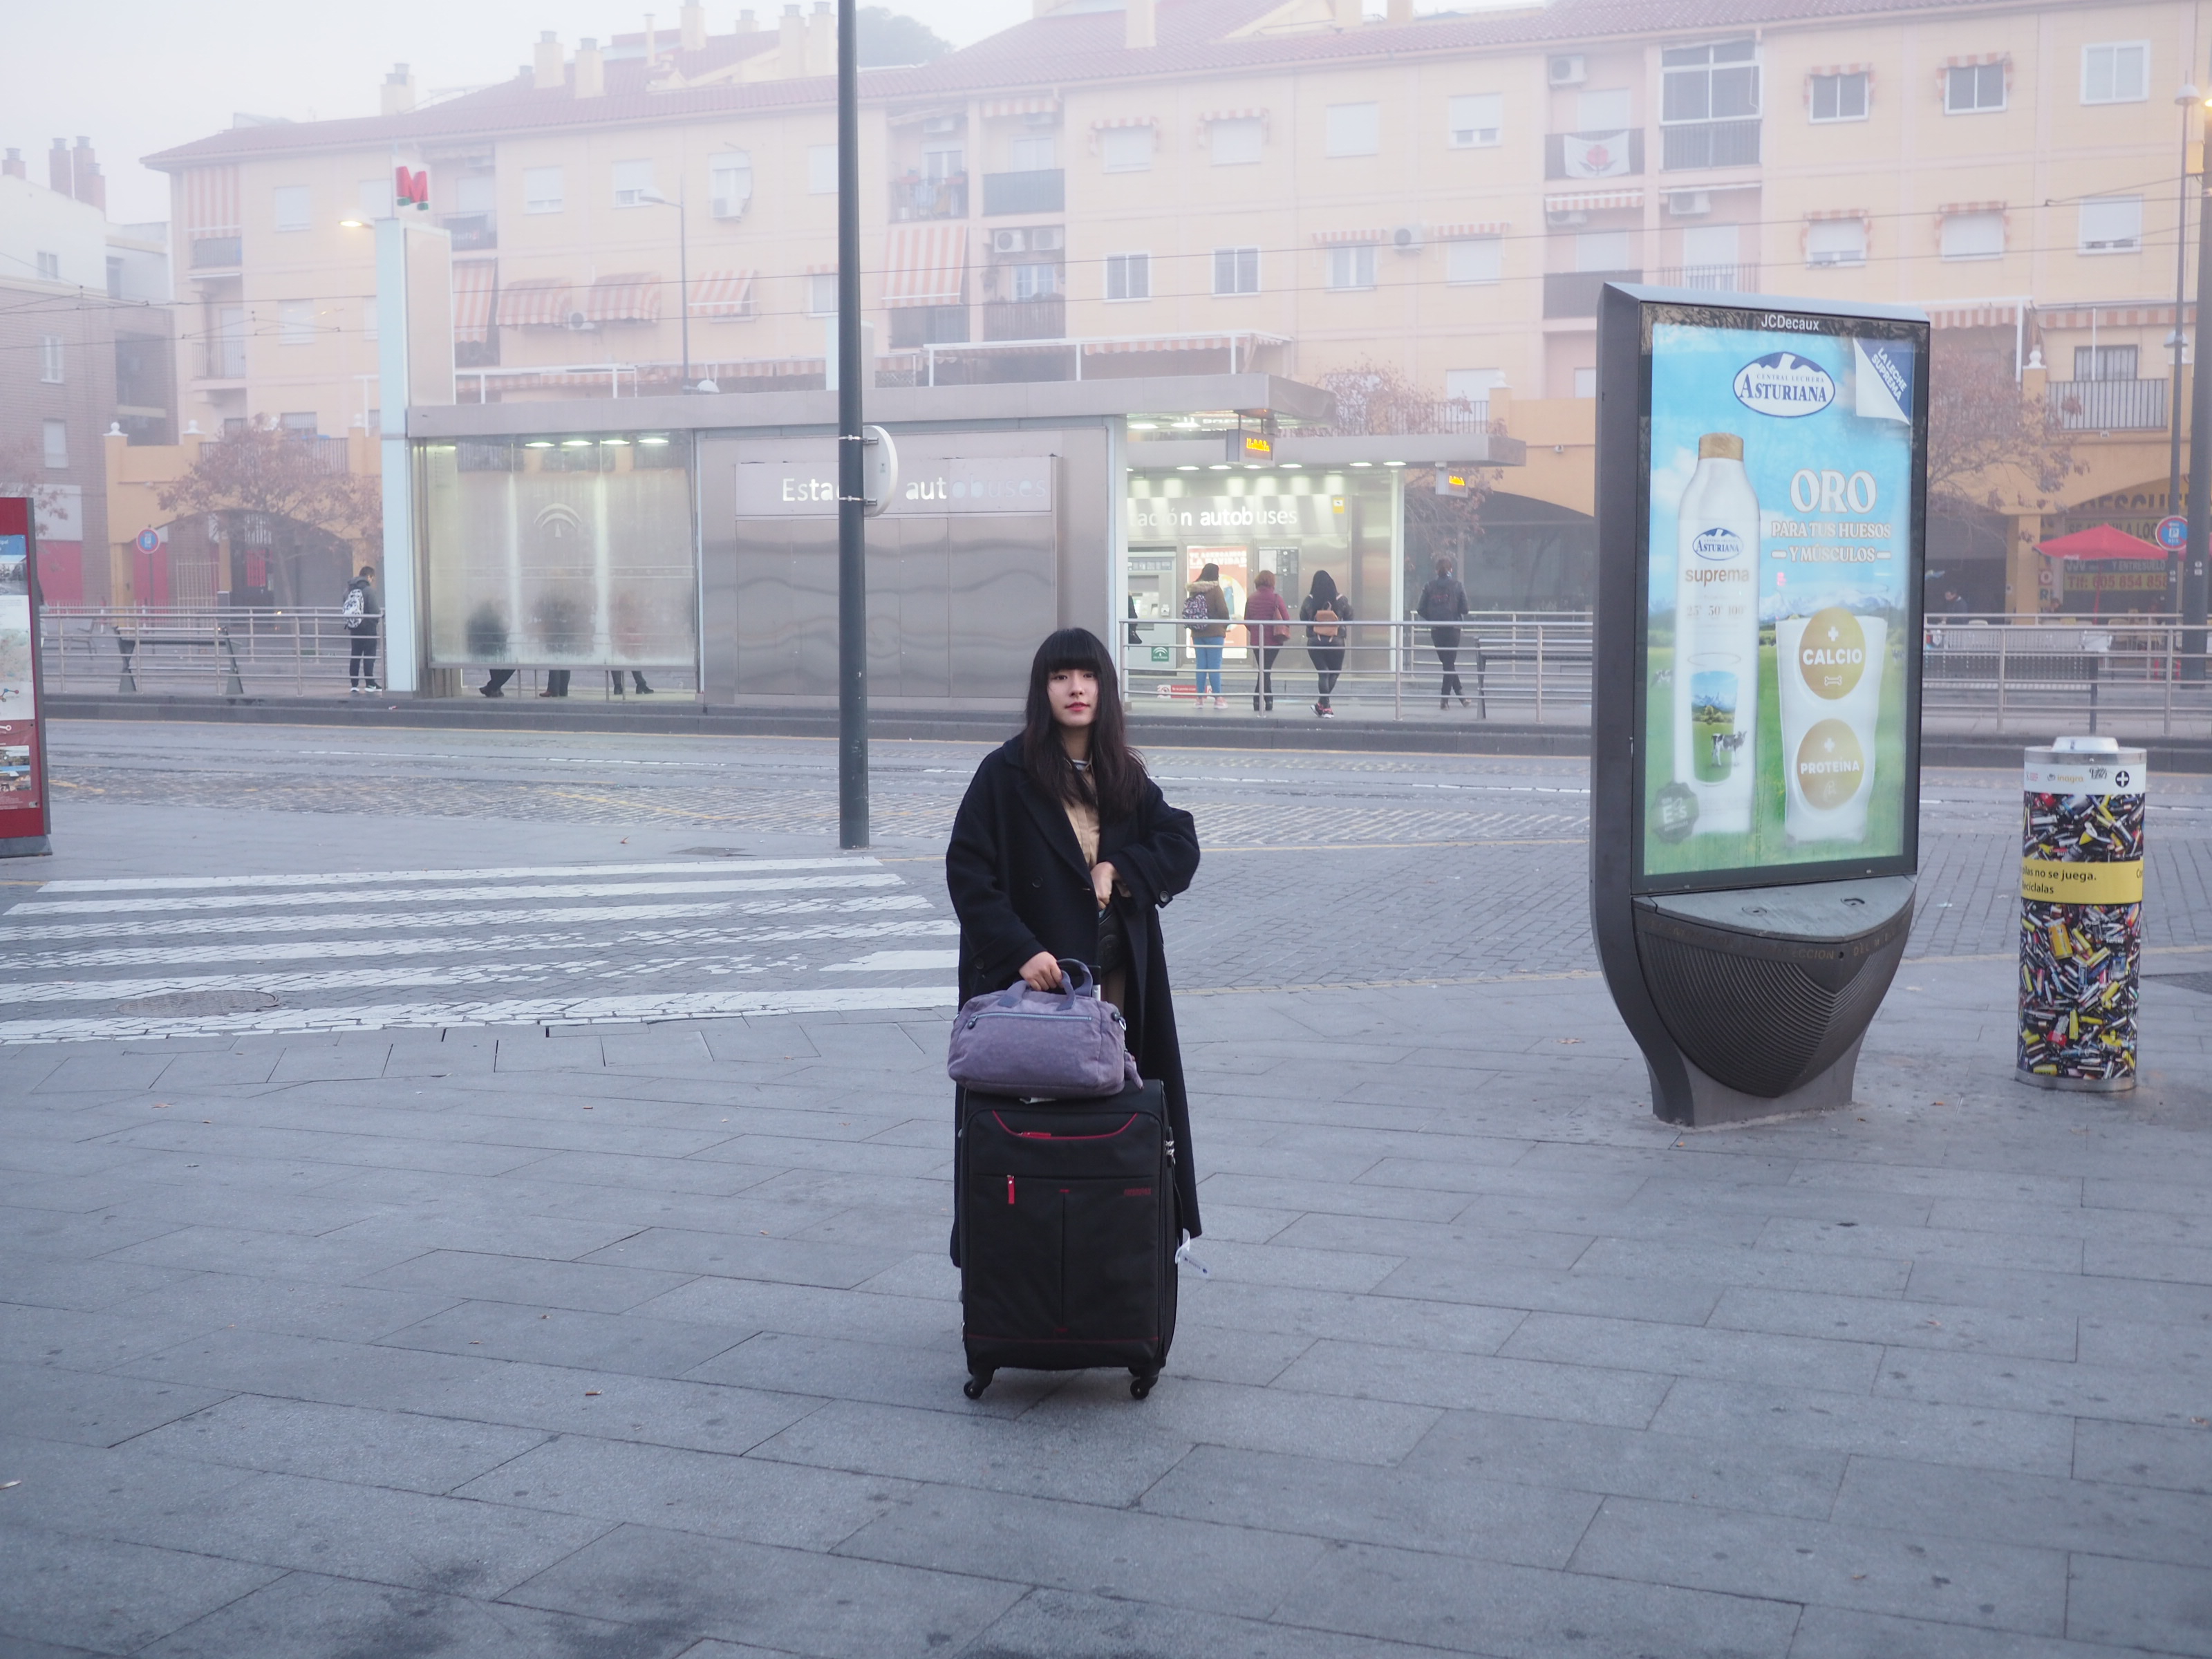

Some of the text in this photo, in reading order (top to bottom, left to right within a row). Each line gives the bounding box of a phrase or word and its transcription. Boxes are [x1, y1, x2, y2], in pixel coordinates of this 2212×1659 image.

[395, 165, 429, 211] M
[1761, 313, 1820, 332] JCDecaux
[1756, 373, 1825, 384] CENTRAL LECHERA
[1871, 353, 1902, 401] SUPREMA
[1877, 347, 1908, 392] LA LECHE
[782, 475, 1047, 503] Esta autobuses
[1790, 467, 1877, 514] ORO
[1199, 505, 1298, 527] autobuses
[1771, 521, 1892, 539] PARA TUS HUESOS
[1788, 542, 1876, 563] Y MÚSCULOS
[1685, 568, 1750, 588] suprema
[2119, 575, 2142, 588] 854
[1802, 648, 1863, 666] CALCIO
[1800, 758, 1861, 775] PROTEÍNA
[2034, 869, 2046, 879] no
[2047, 870, 2059, 880] se
[2061, 868, 2097, 883] juega.
